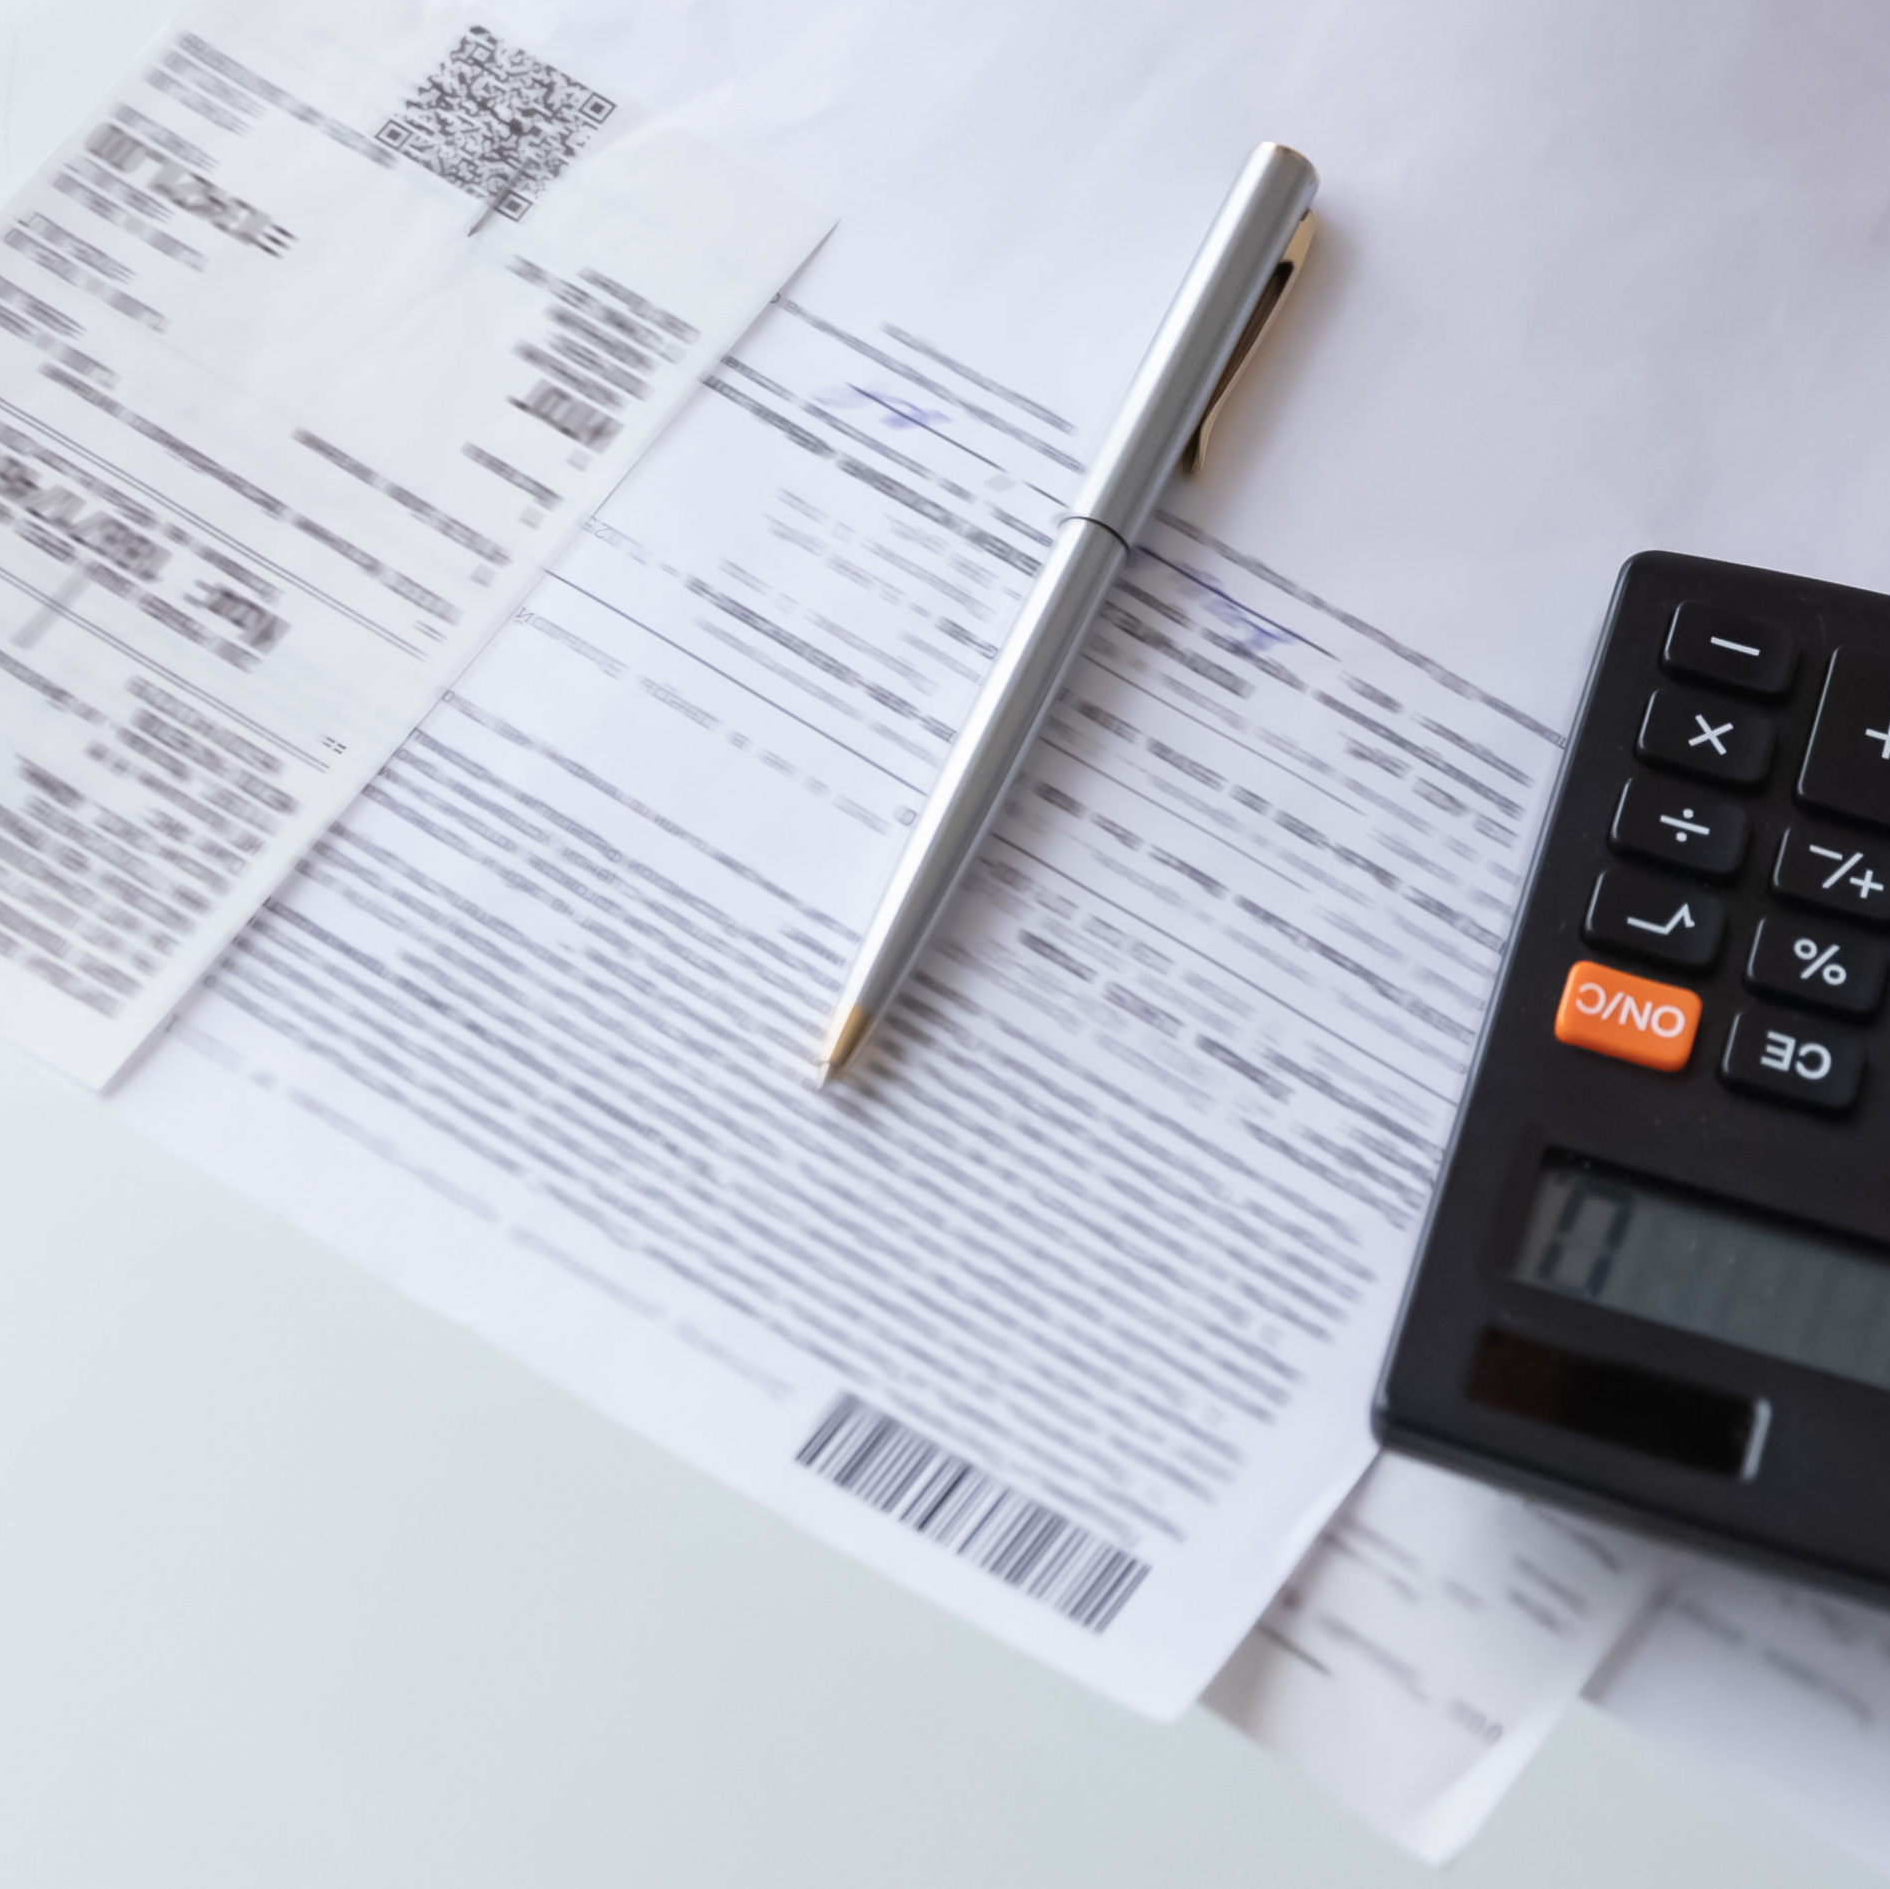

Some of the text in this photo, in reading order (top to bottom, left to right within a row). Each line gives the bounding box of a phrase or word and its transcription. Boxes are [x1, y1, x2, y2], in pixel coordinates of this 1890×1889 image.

[1792, 937, 1848, 987] %
[1573, 980, 1689, 1042] ON/C
[1760, 1030, 1833, 1081] CE
